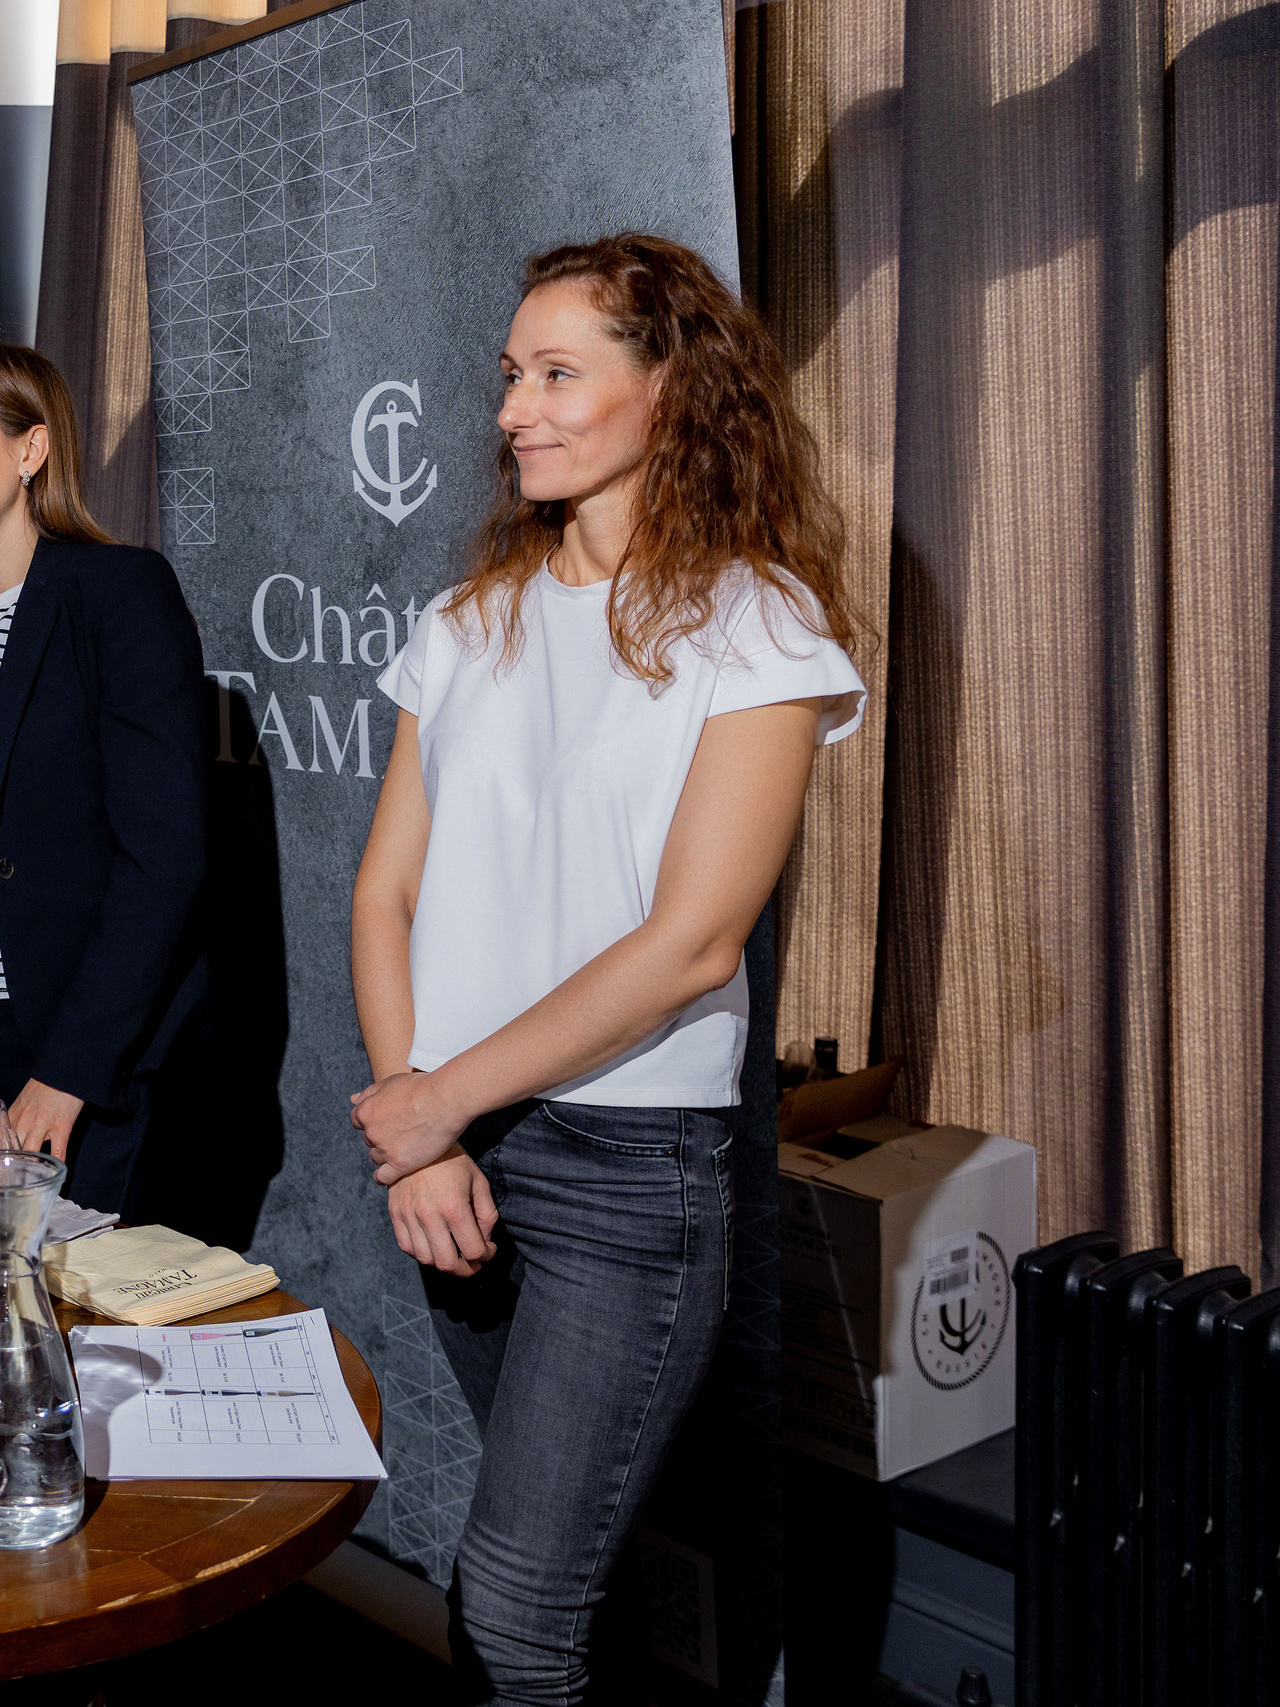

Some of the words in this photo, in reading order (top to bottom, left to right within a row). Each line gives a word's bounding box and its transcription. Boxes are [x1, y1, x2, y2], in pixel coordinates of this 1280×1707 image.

[251, 573, 422, 668] Chât
[203, 670, 386, 780] TAM
[778, 1230, 841, 1259] AMAGNE
[112, 1269, 198, 1295] TAMAGNE
